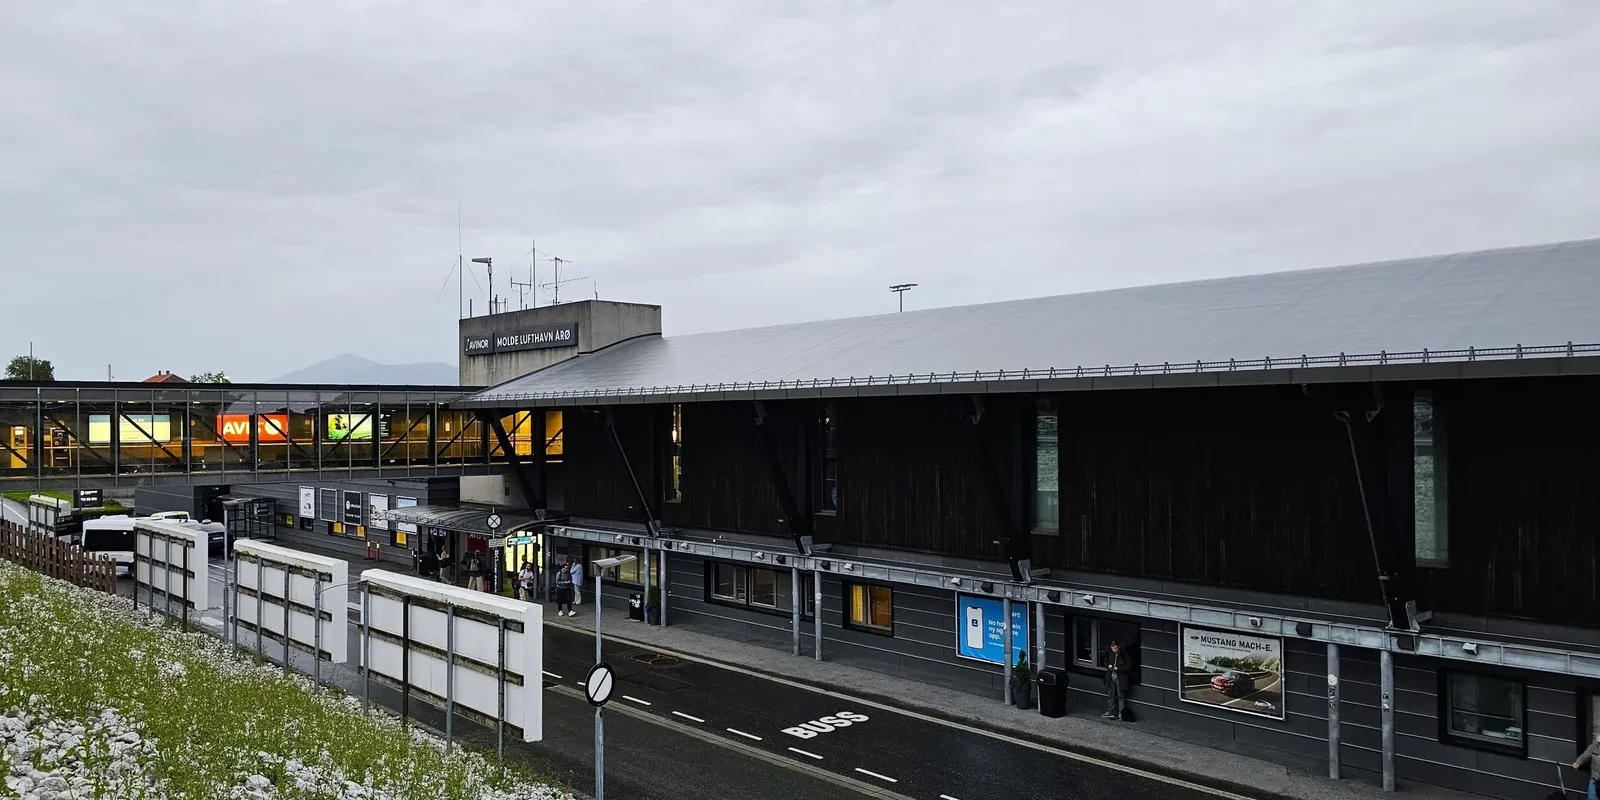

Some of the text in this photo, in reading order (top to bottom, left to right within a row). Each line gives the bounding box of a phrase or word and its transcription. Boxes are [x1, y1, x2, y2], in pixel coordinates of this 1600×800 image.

[469, 339, 489, 349] AVINOR
[497, 336, 519, 347] MOLDE
[520, 332, 553, 345] LUFTHAVN
[1201, 636, 1236, 647] MUSTANG
[1239, 641, 1272, 652] MACH-E.
[781, 711, 869, 739] BUSS
